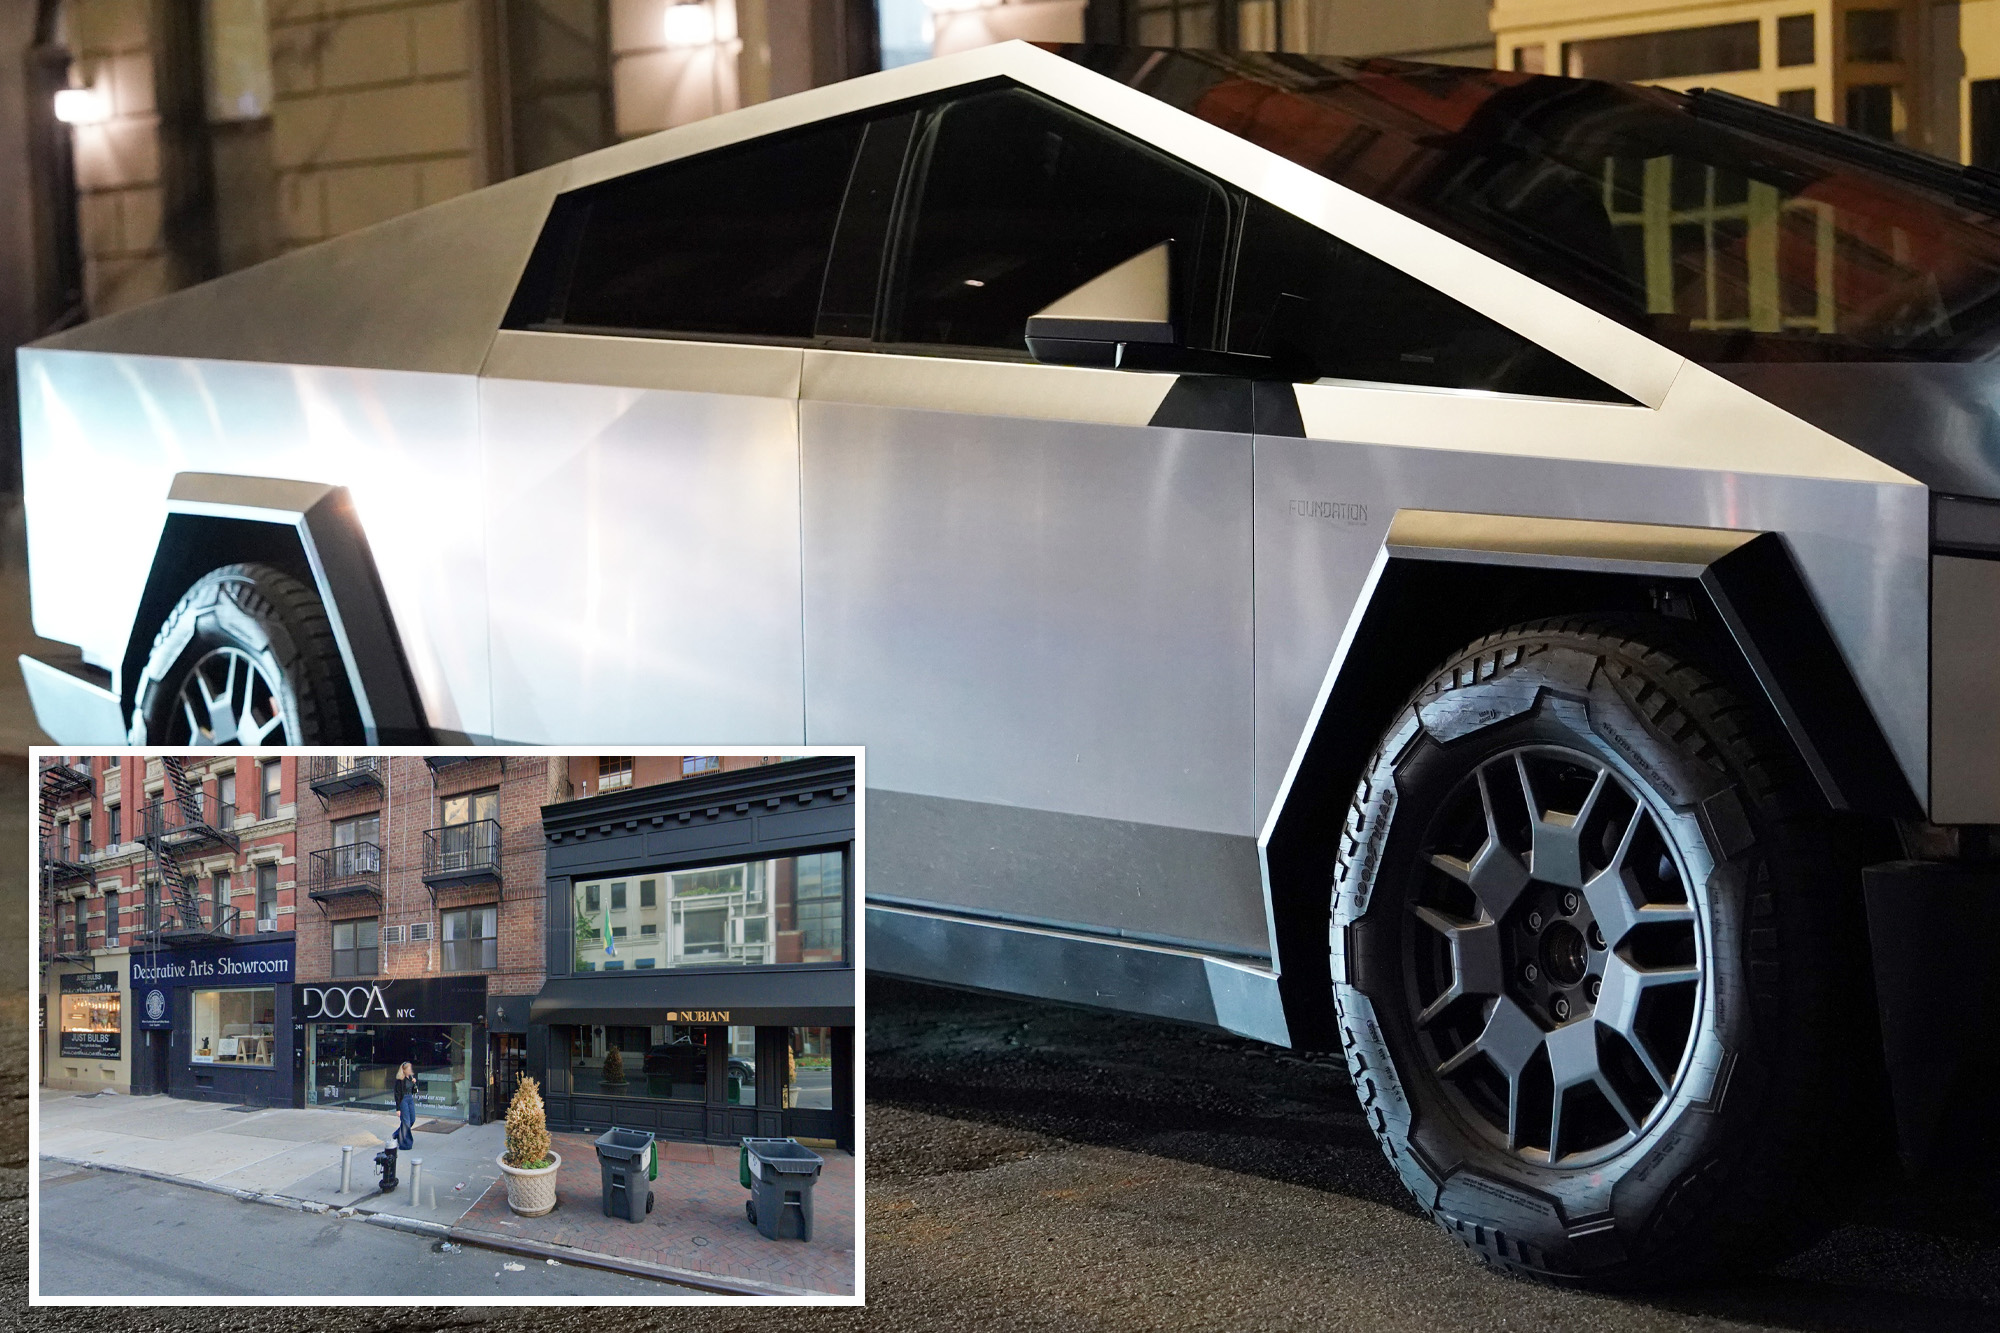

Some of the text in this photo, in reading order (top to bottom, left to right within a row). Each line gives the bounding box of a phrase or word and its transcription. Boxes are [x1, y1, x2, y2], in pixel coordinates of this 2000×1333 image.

[1288, 499, 1369, 521] FOUNDATION
[1354, 789, 1393, 908] GOODYEAR
[87, 973, 102, 981] BULBS
[133, 957, 289, 980] Decorative Arts Showroom
[303, 985, 416, 1019] DOCA NYC
[680, 1011, 730, 1022] NUBIANI
[71, 1033, 109, 1043] JUST BULBS
